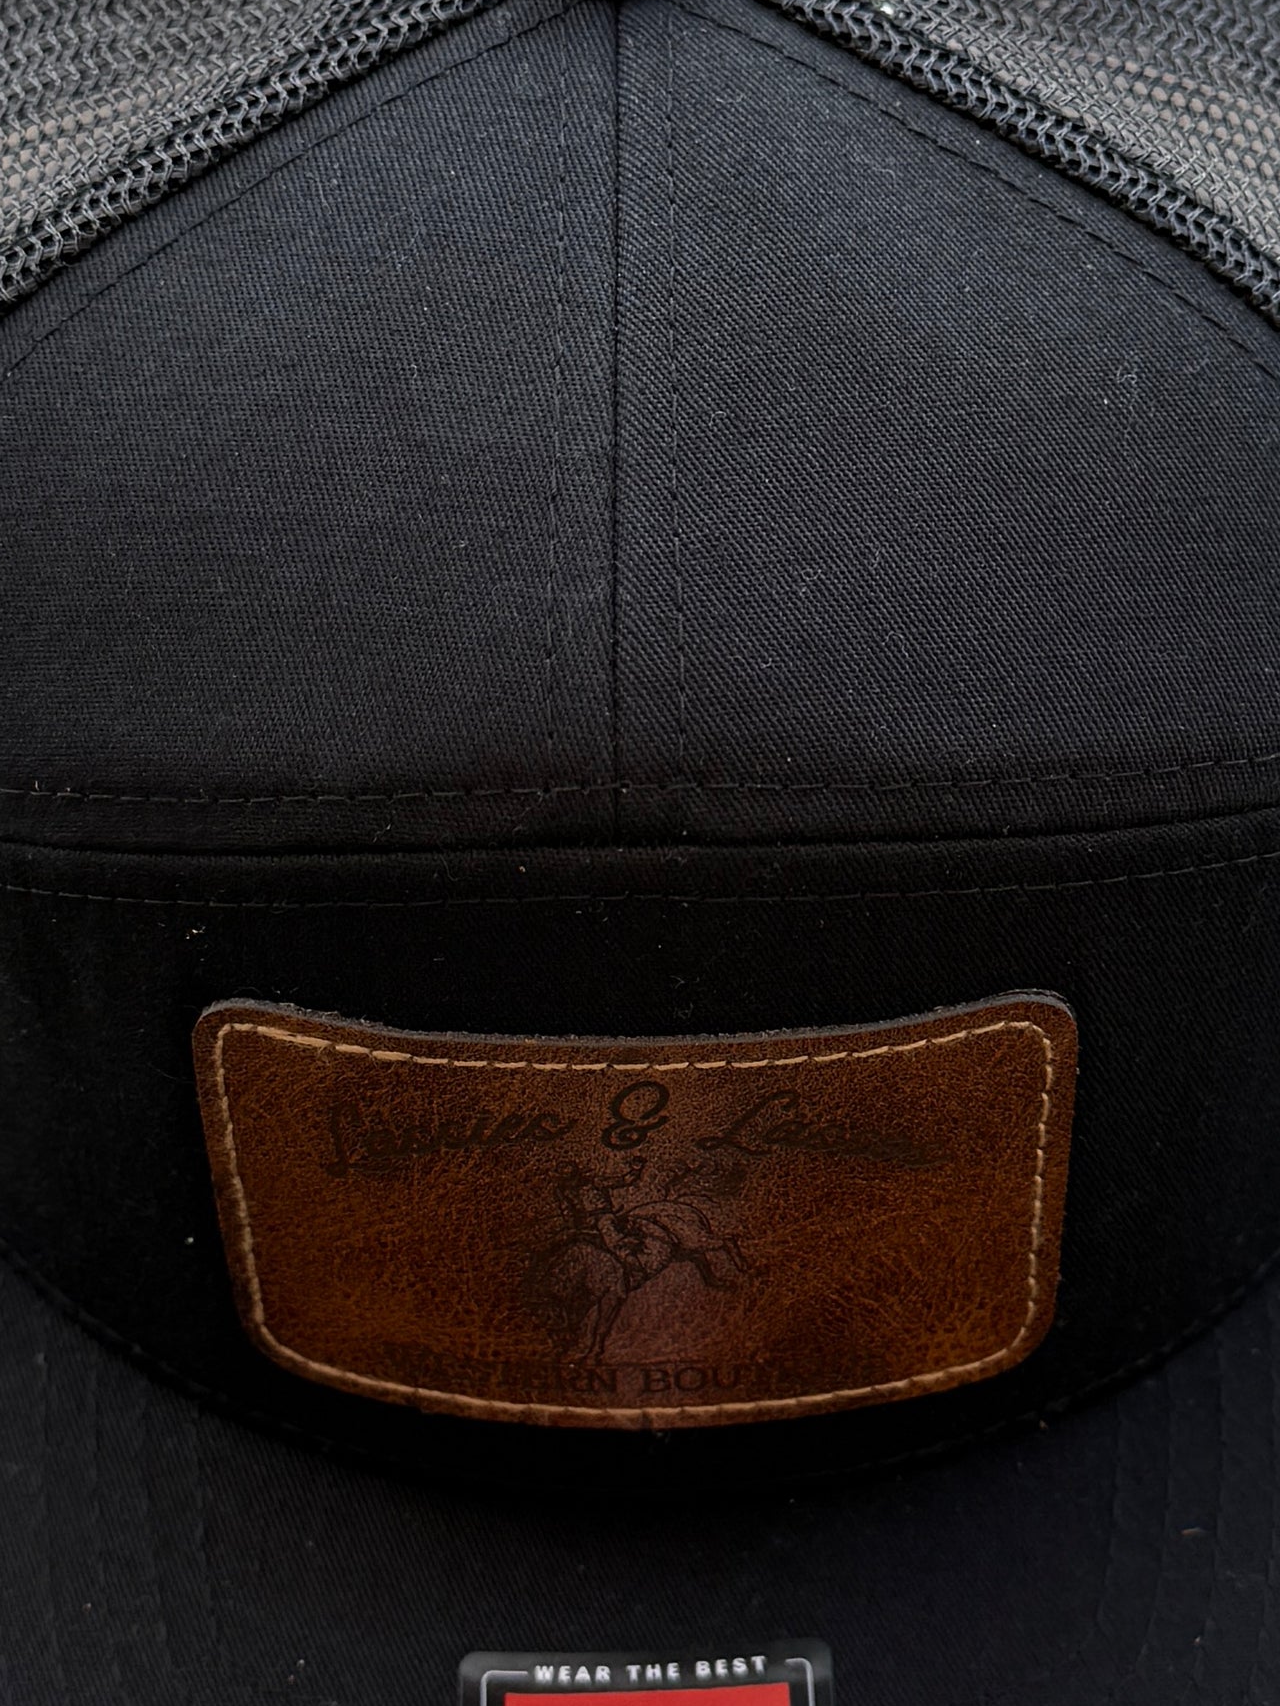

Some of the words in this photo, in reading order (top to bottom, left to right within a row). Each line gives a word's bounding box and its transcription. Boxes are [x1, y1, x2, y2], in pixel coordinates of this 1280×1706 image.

[600, 1080, 670, 1151] &
[534, 1663, 611, 1683] WEAR
[627, 1662, 680, 1681] THE
[695, 1655, 767, 1680] BEST
